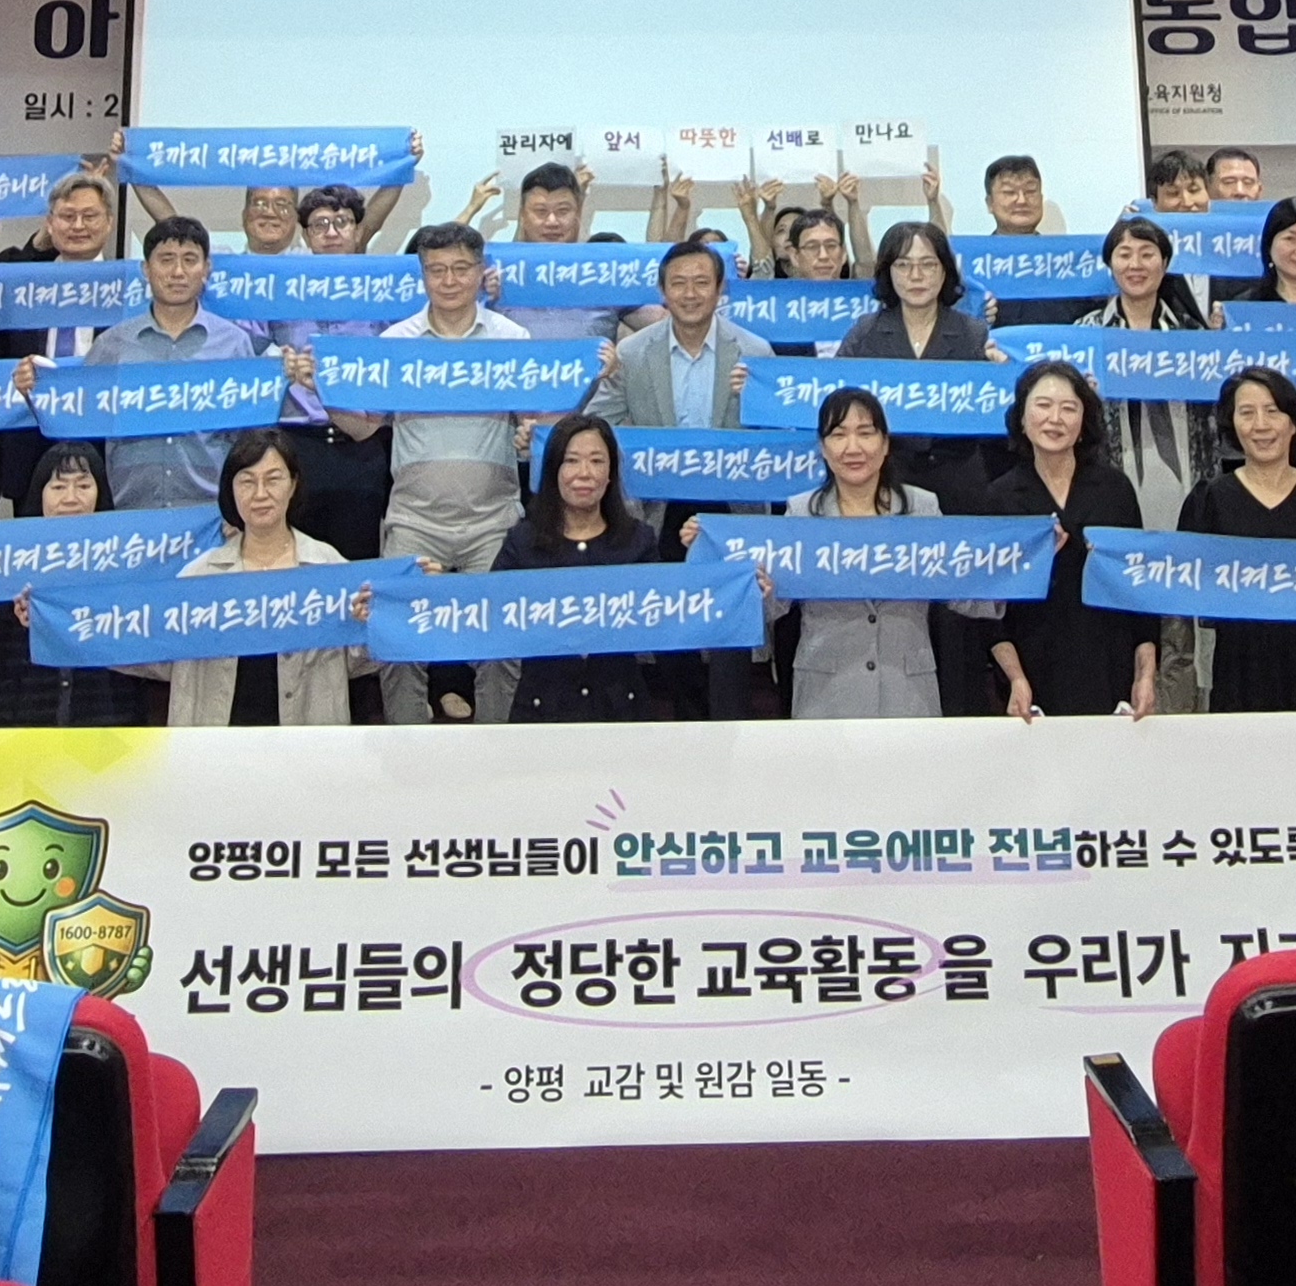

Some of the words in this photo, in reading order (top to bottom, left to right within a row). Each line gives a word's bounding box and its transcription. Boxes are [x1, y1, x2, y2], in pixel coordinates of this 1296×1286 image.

[23, 91, 75, 120] 일시
[1147, 82, 1223, 104] 육지원청
[499, 132, 574, 154] 관리자에
[604, 130, 641, 151] 앞서
[679, 126, 738, 148] 따뜻한
[766, 128, 824, 150] 선배로
[855, 122, 915, 144] 만나요
[147, 141, 209, 168] 끝까지
[217, 141, 384, 171] 지켜드리겠습니다.
[535, 259, 658, 288] 지켜드리겠습
[972, 250, 1107, 281] 지켜드리겠습
[14, 278, 151, 308] 지켜드리겠습
[209, 270, 275, 301] 끝까지
[285, 270, 425, 305] 지켜드리겠습
[318, 355, 390, 388] 끝까지
[401, 358, 591, 391] 지켜드리겠습니다.
[33, 386, 84, 417] 까지
[861, 380, 1015, 413] 켜드리겠습니
[633, 447, 825, 481] 지켜드리겠습니다.
[815, 540, 1030, 578] 지켜드리겠습니다.
[1122, 552, 1202, 591] 끝까지
[68, 603, 150, 642] 끝까지
[408, 598, 489, 634] 끝까지
[502, 588, 723, 631] 지켜드리겠습니다.
[187, 838, 301, 880] 양평의
[315, 841, 389, 878] 모든
[404, 837, 599, 876] 선생님들이
[612, 830, 783, 876] 안심하고
[799, 830, 975, 872] 교육에만
[988, 827, 1149, 872] 전념하실
[1162, 829, 1198, 868] 수
[59, 924, 133, 942] 1600-8787
[180, 941, 463, 1014] 선생님들의
[511, 937, 681, 1008] 정당한
[696, 933, 993, 1004] 교육활동을
[1023, 929, 1191, 998] 우리가
[585, 1064, 645, 1100] 교감
[656, 1065, 684, 1100] 및
[693, 1062, 757, 1099] 원감
